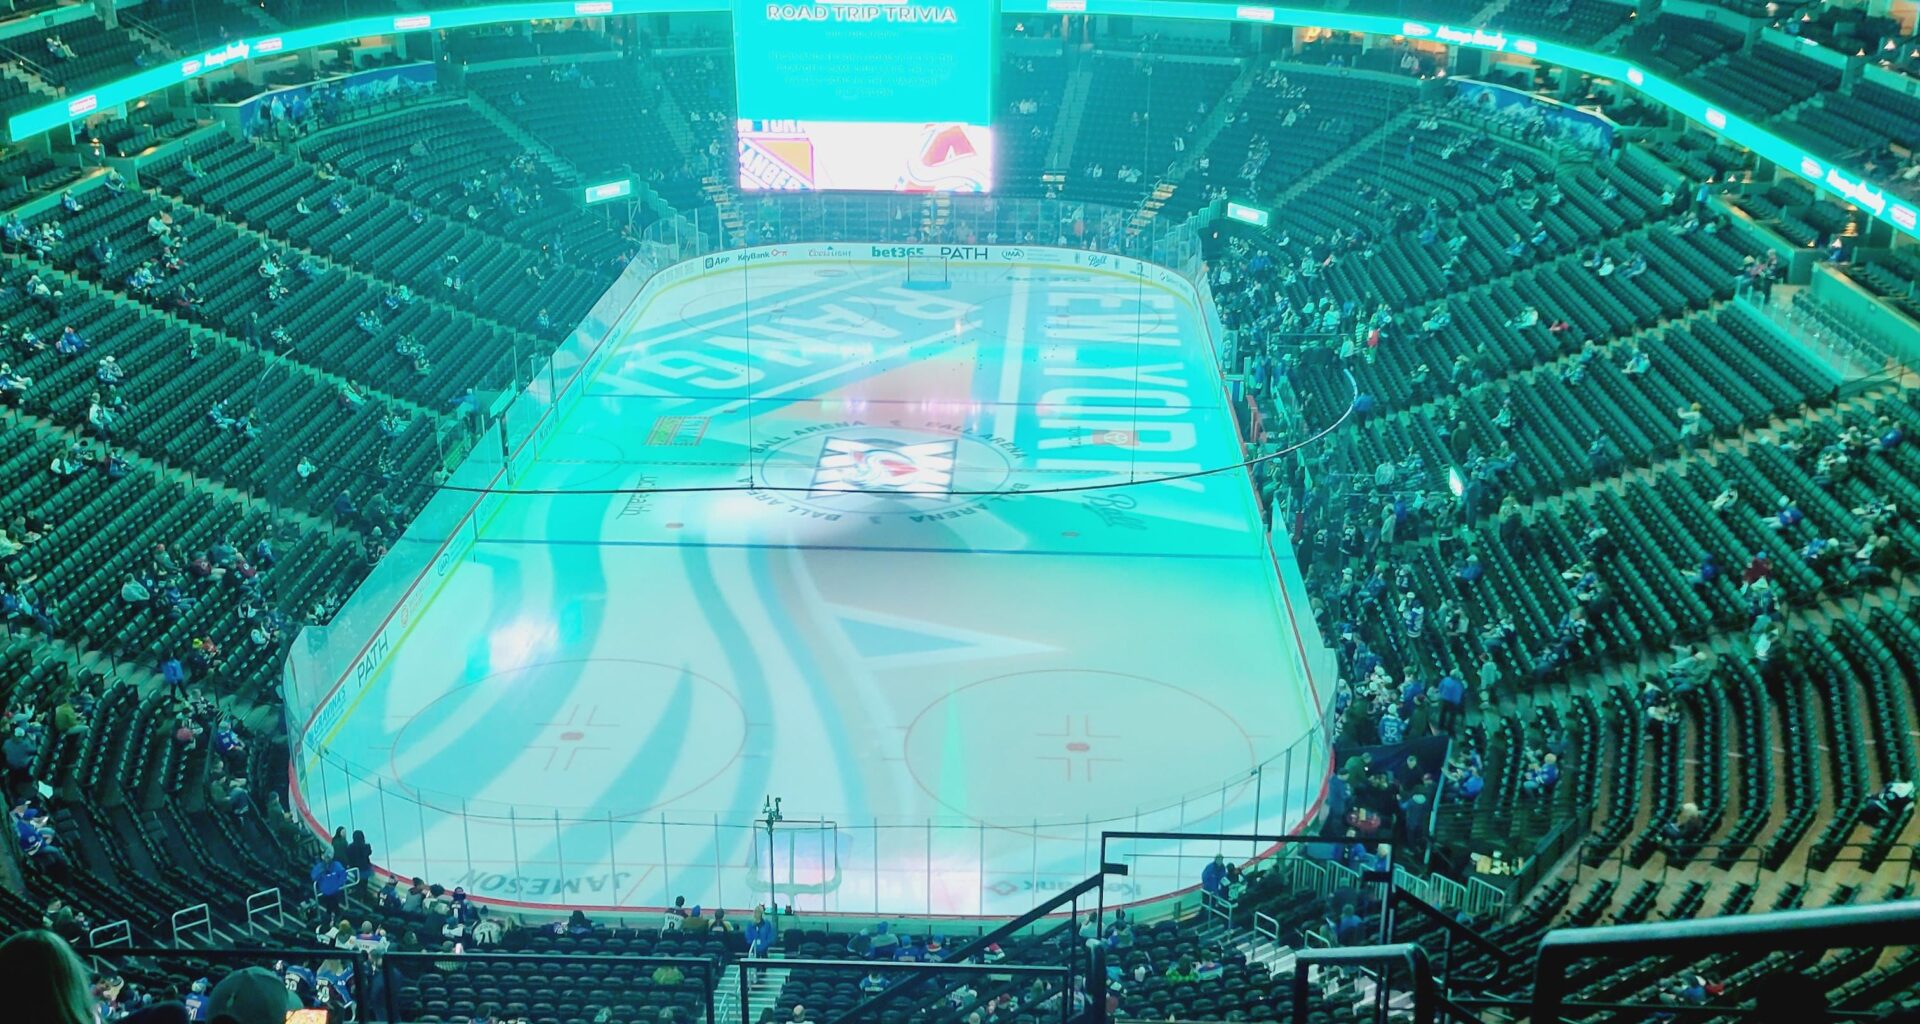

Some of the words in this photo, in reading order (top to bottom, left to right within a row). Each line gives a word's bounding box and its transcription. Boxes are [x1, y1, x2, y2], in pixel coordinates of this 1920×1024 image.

[766, 5, 827, 21] ROAD
[832, 6, 881, 21] TRIP
[886, 6, 957, 22] TRIVIA
[871, 246, 925, 259] bet365
[940, 246, 988, 260] PATH
[356, 631, 389, 688] PATH
[454, 867, 631, 896] JAMESON
